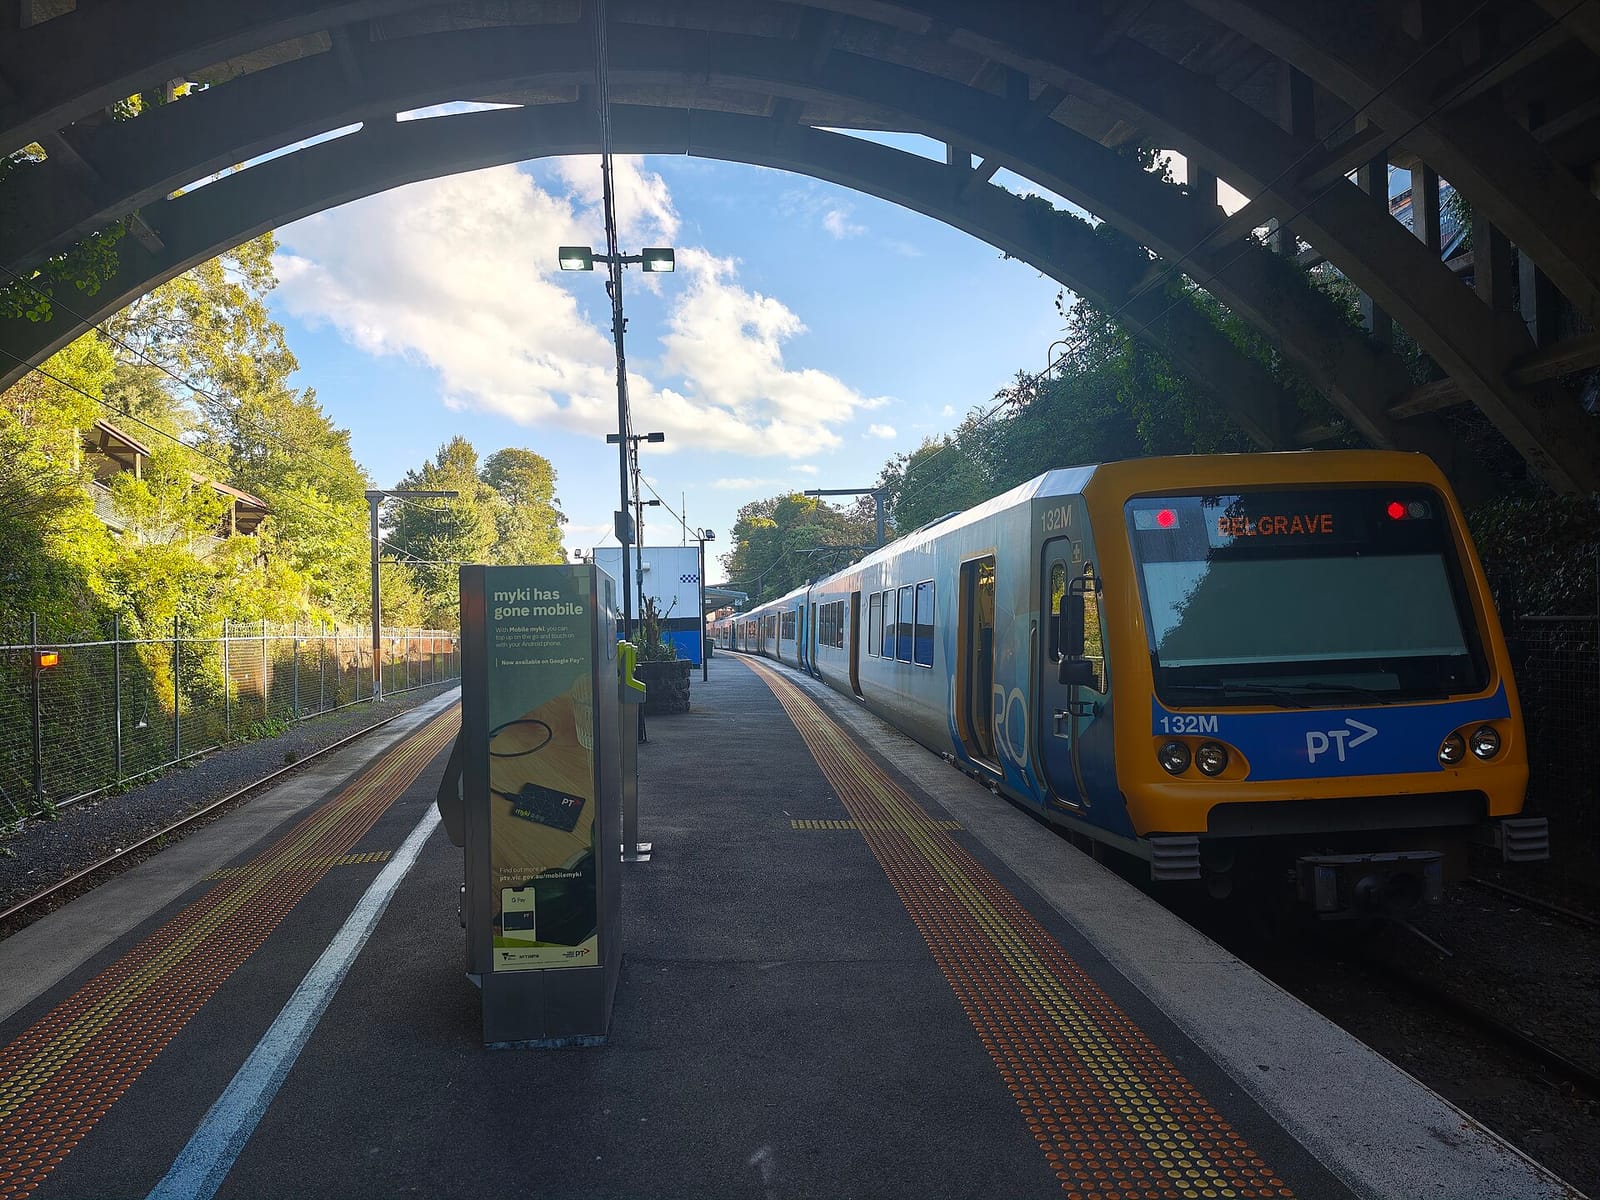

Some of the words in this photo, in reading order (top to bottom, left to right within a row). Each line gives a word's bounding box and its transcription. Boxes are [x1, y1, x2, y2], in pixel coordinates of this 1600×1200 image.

[1040, 504, 1072, 532] 132M
[1217, 514, 1333, 537] BELGRAVE
[494, 588, 531, 604] myki
[534, 588, 560, 600] has
[494, 606, 530, 620] gone
[533, 602, 583, 616] mobile
[1160, 715, 1218, 733] 132M
